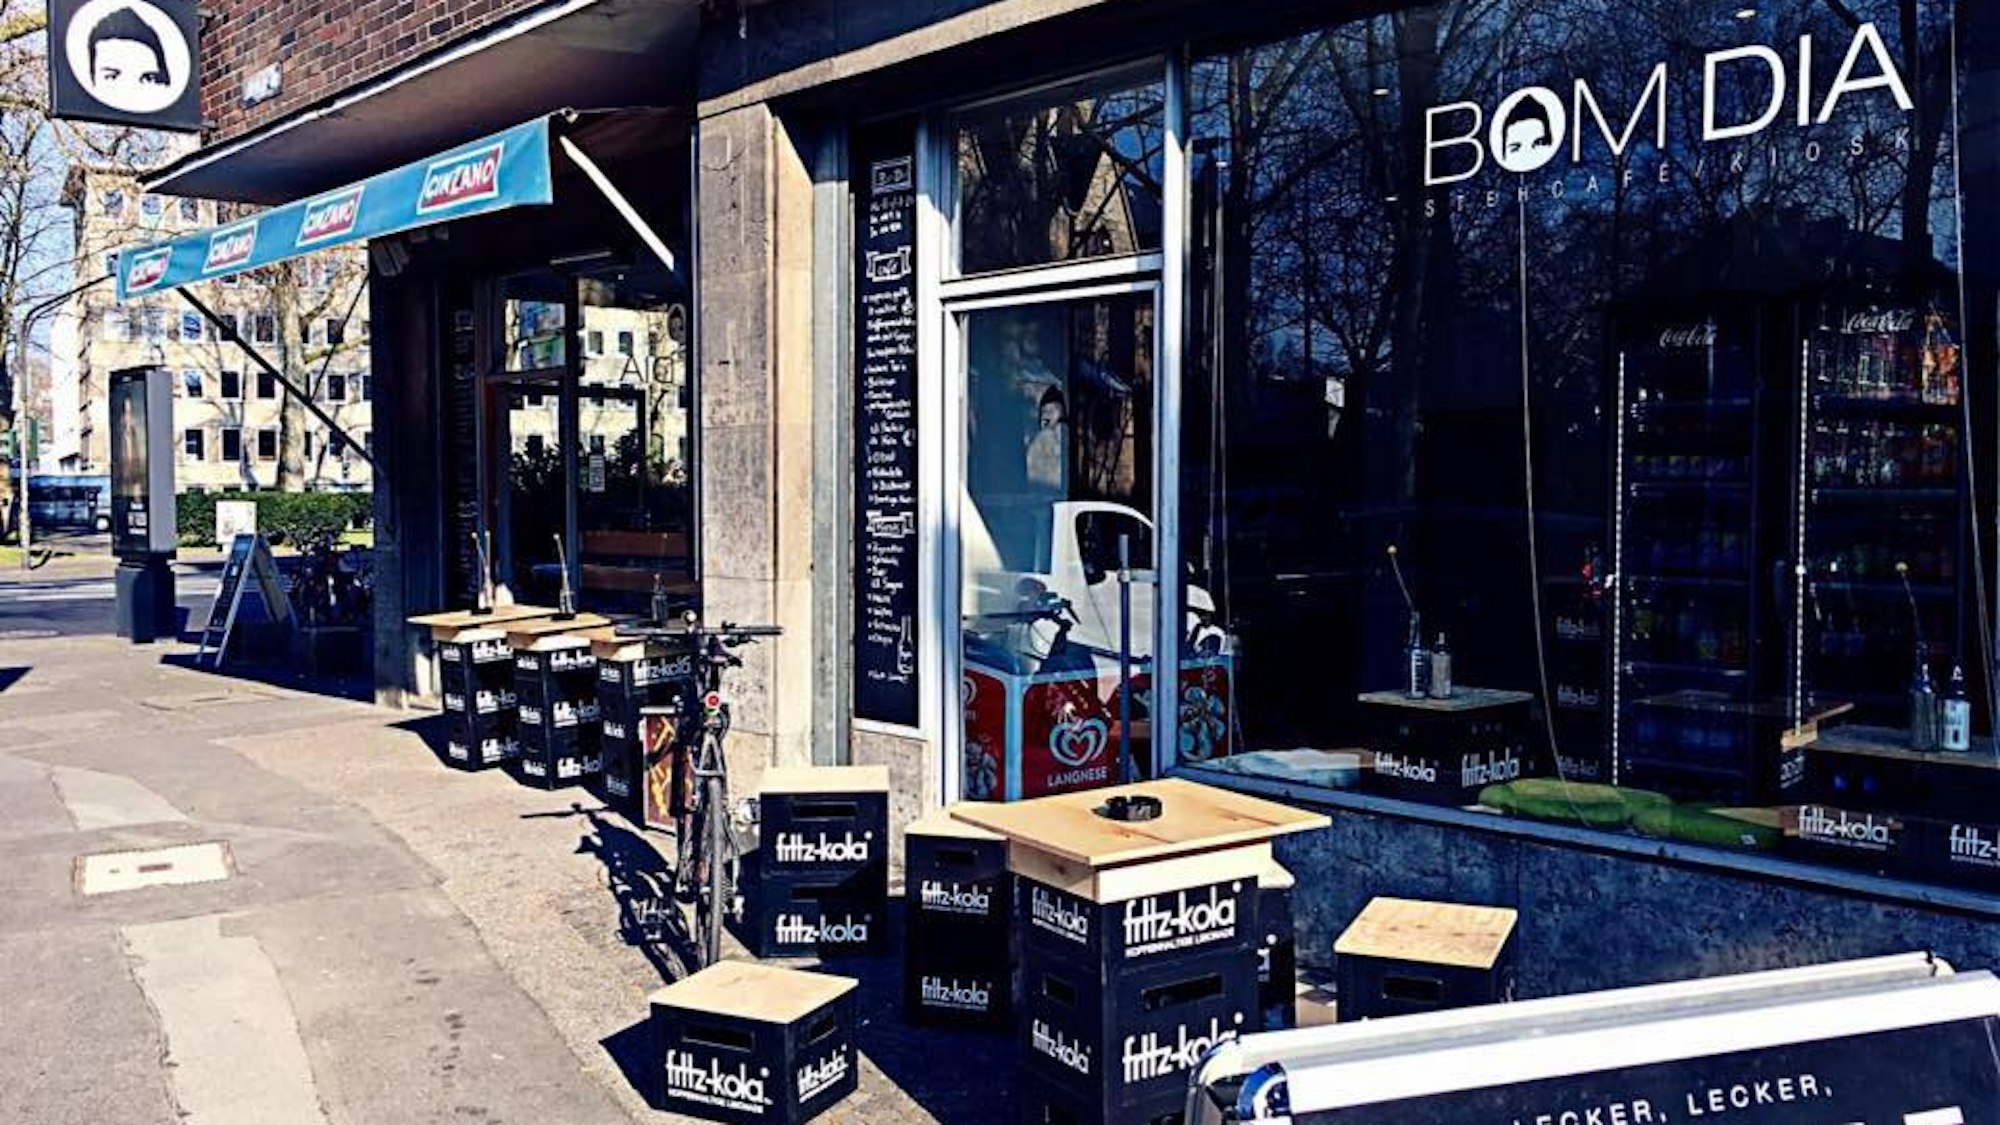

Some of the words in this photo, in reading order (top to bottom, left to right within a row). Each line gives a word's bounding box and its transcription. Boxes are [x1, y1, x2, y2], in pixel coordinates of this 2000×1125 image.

[1424, 62, 1667, 186] BOM
[1703, 22, 1915, 141] DIA
[1721, 127, 1909, 174] KIOSK
[424, 158, 495, 200] CINZANO
[1047, 767, 1108, 787] LANGNESE
[1375, 750, 1437, 782] fritz-kola
[1461, 746, 1521, 789] fritz-kola
[1798, 804, 1890, 844] fritz-kola
[775, 831, 869, 863] fritz-kola
[920, 880, 989, 909] fritz-kola
[1032, 886, 1088, 936] fritz-kola
[1122, 884, 1236, 946] fritz-kola
[775, 914, 869, 944] fritz-kola
[920, 976, 990, 1005] fritz-kola
[1032, 1018, 1089, 1074] fritz-kola
[666, 1049, 765, 1103] fritz-kola
[1686, 1073, 1833, 1116] LECKER,
